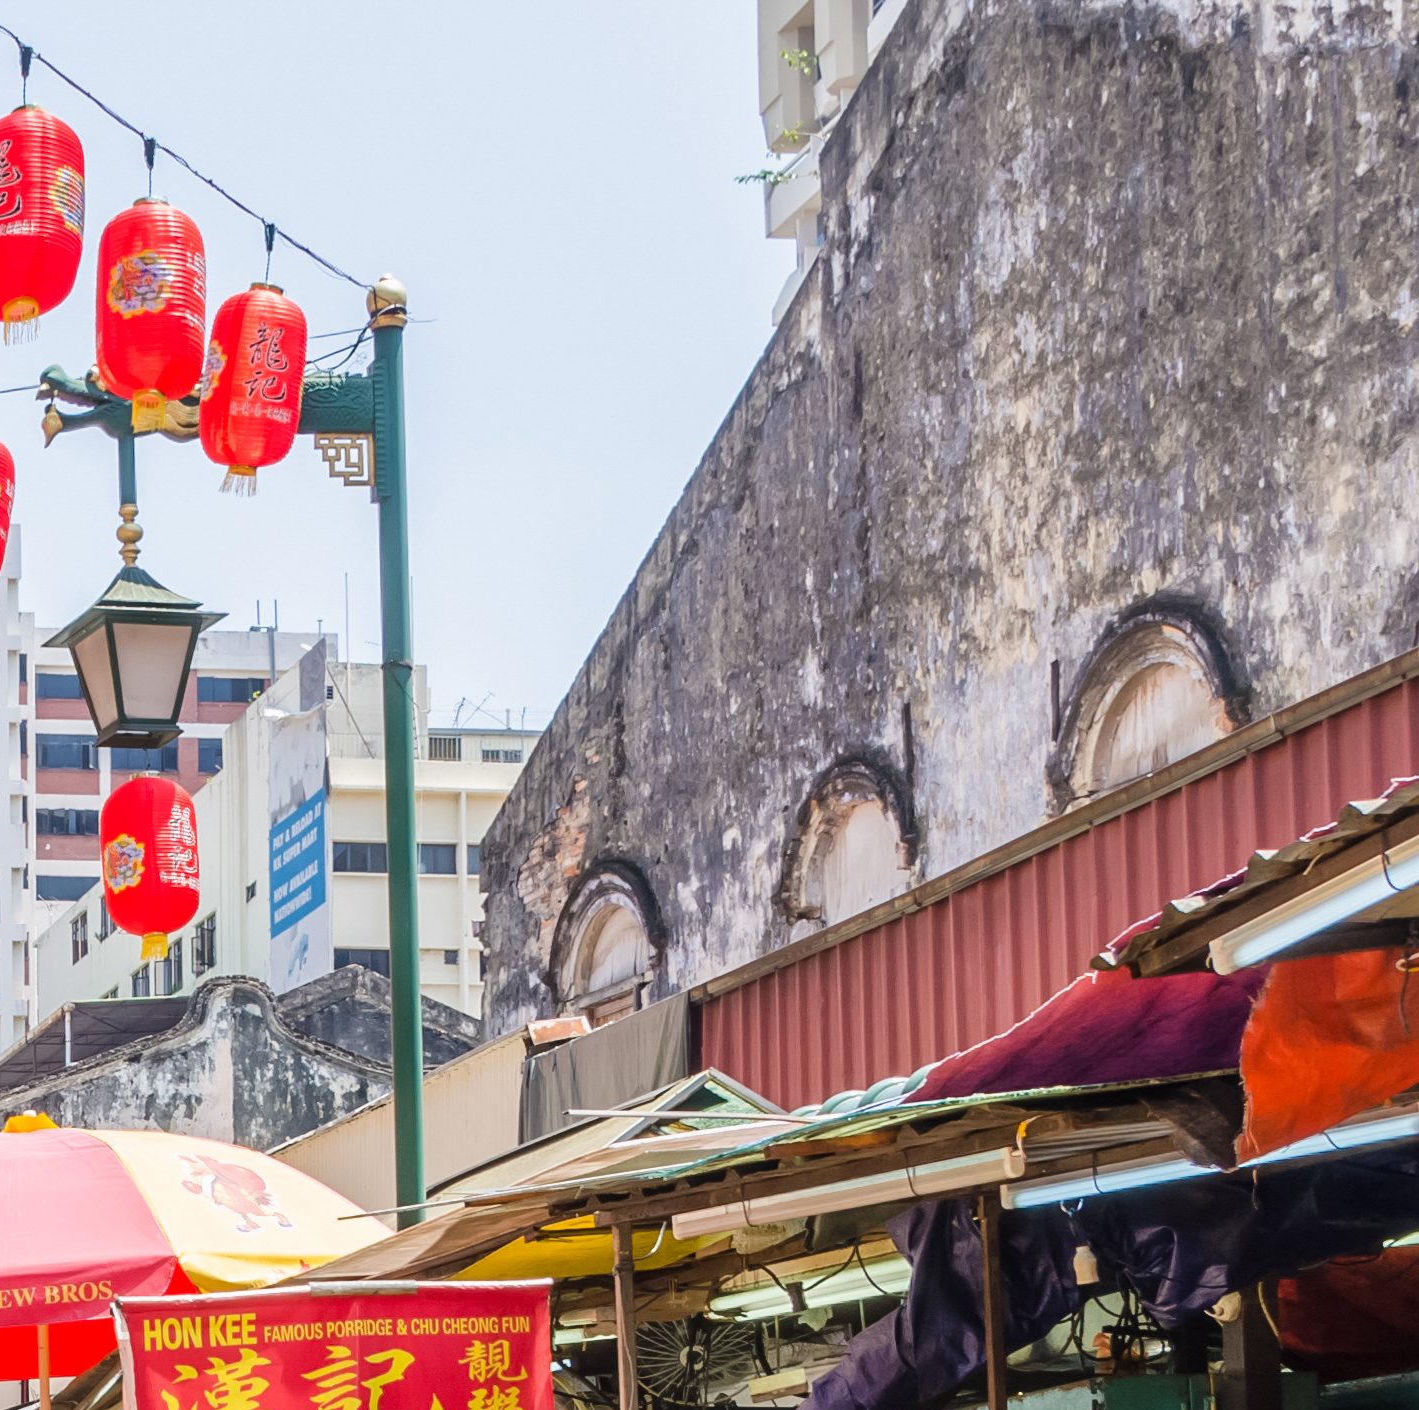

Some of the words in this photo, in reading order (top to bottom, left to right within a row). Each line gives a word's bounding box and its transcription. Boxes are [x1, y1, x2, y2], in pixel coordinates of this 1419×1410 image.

[291, 810, 314, 839] RELOAD
[283, 841, 301, 866] SUPER
[301, 827, 318, 852] MART
[289, 860, 319, 893] AVAILABLE
[44, 1279, 119, 1308] BROS.
[143, 1316, 203, 1351] HON
[209, 1313, 258, 1347] KEE
[264, 1322, 323, 1343] FAMOUS
[326, 1318, 393, 1340] PORRIDGE
[396, 1319, 408, 1336] &
[411, 1318, 439, 1335] CHU
[442, 1317, 499, 1335] CHEONG
[502, 1316, 530, 1333] FUN
